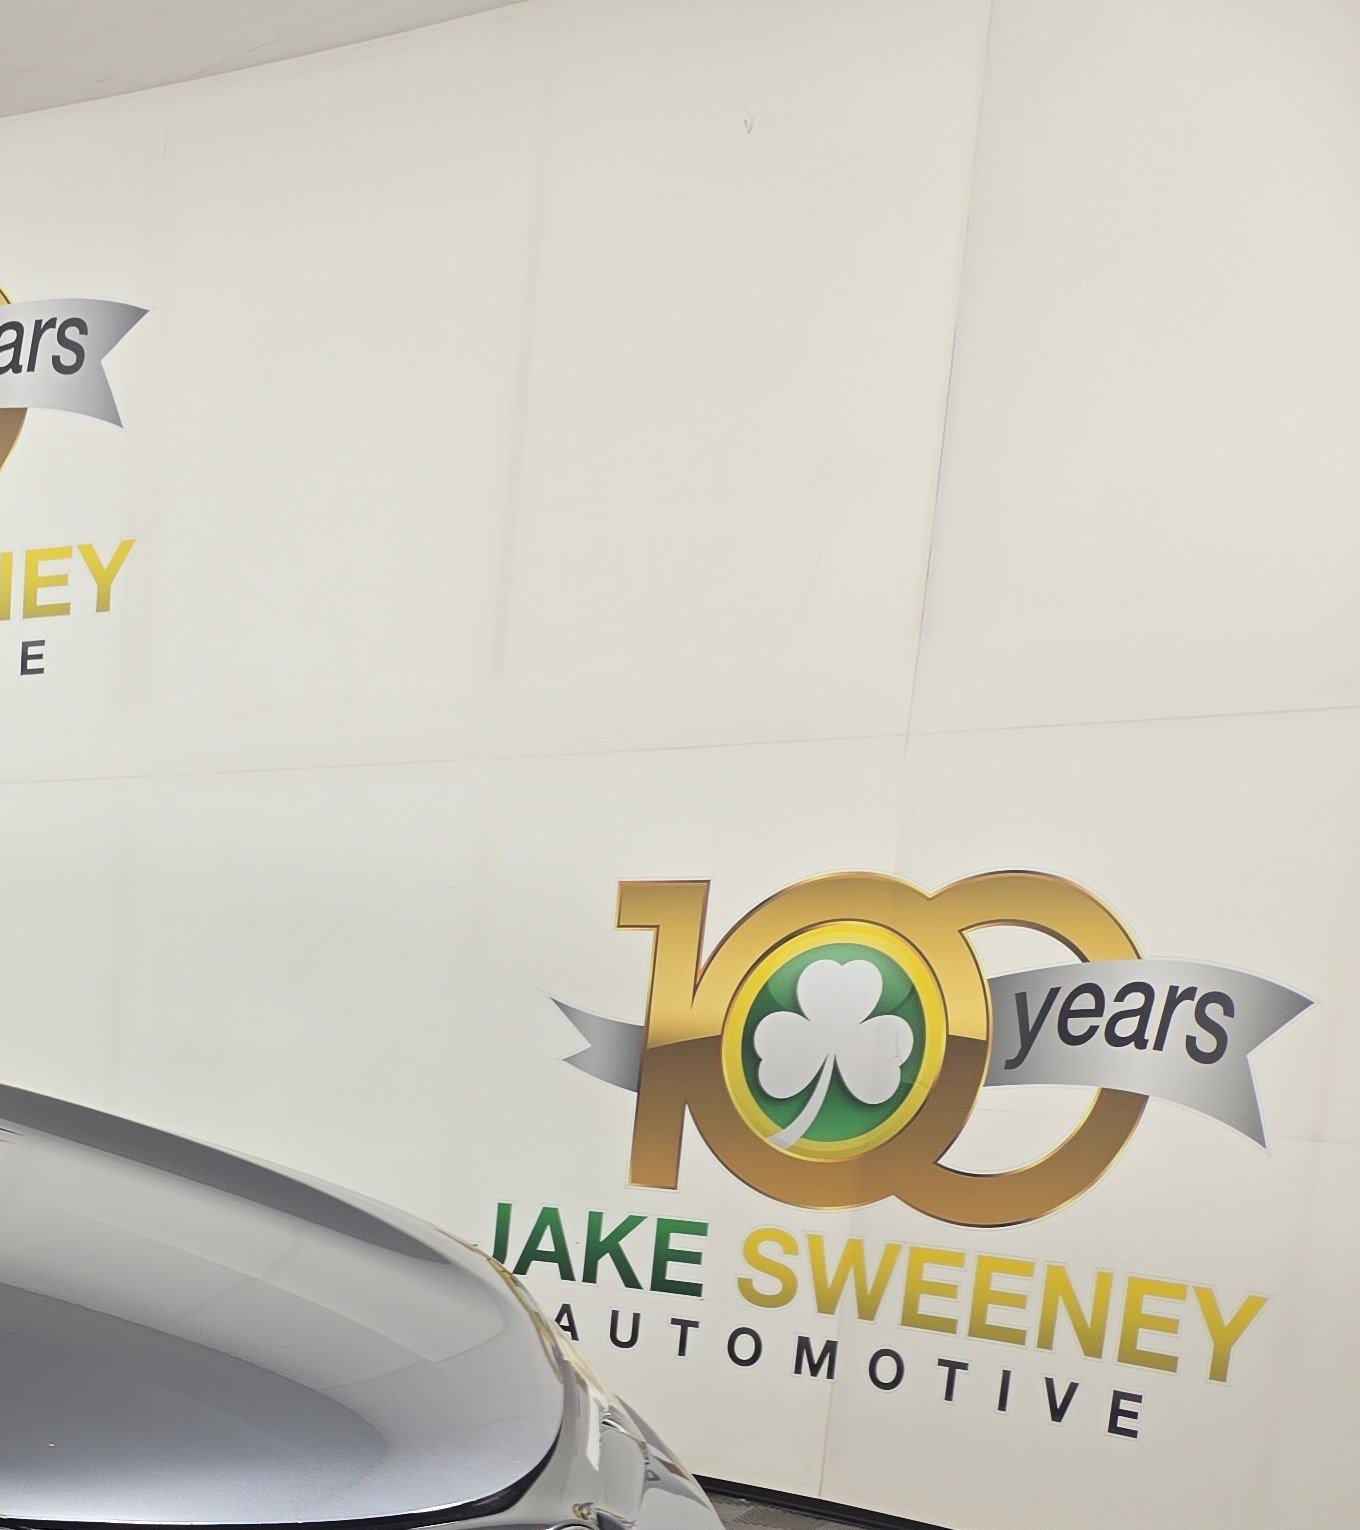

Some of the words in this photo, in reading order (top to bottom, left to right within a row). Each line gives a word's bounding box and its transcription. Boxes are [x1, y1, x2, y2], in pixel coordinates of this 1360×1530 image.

[615, 869, 1149, 1228] 100
[1004, 978, 1236, 1071] years
[554, 1303, 1144, 1441] AUTOMOTIVE
[737, 1227, 1268, 1384] SWEENEY
